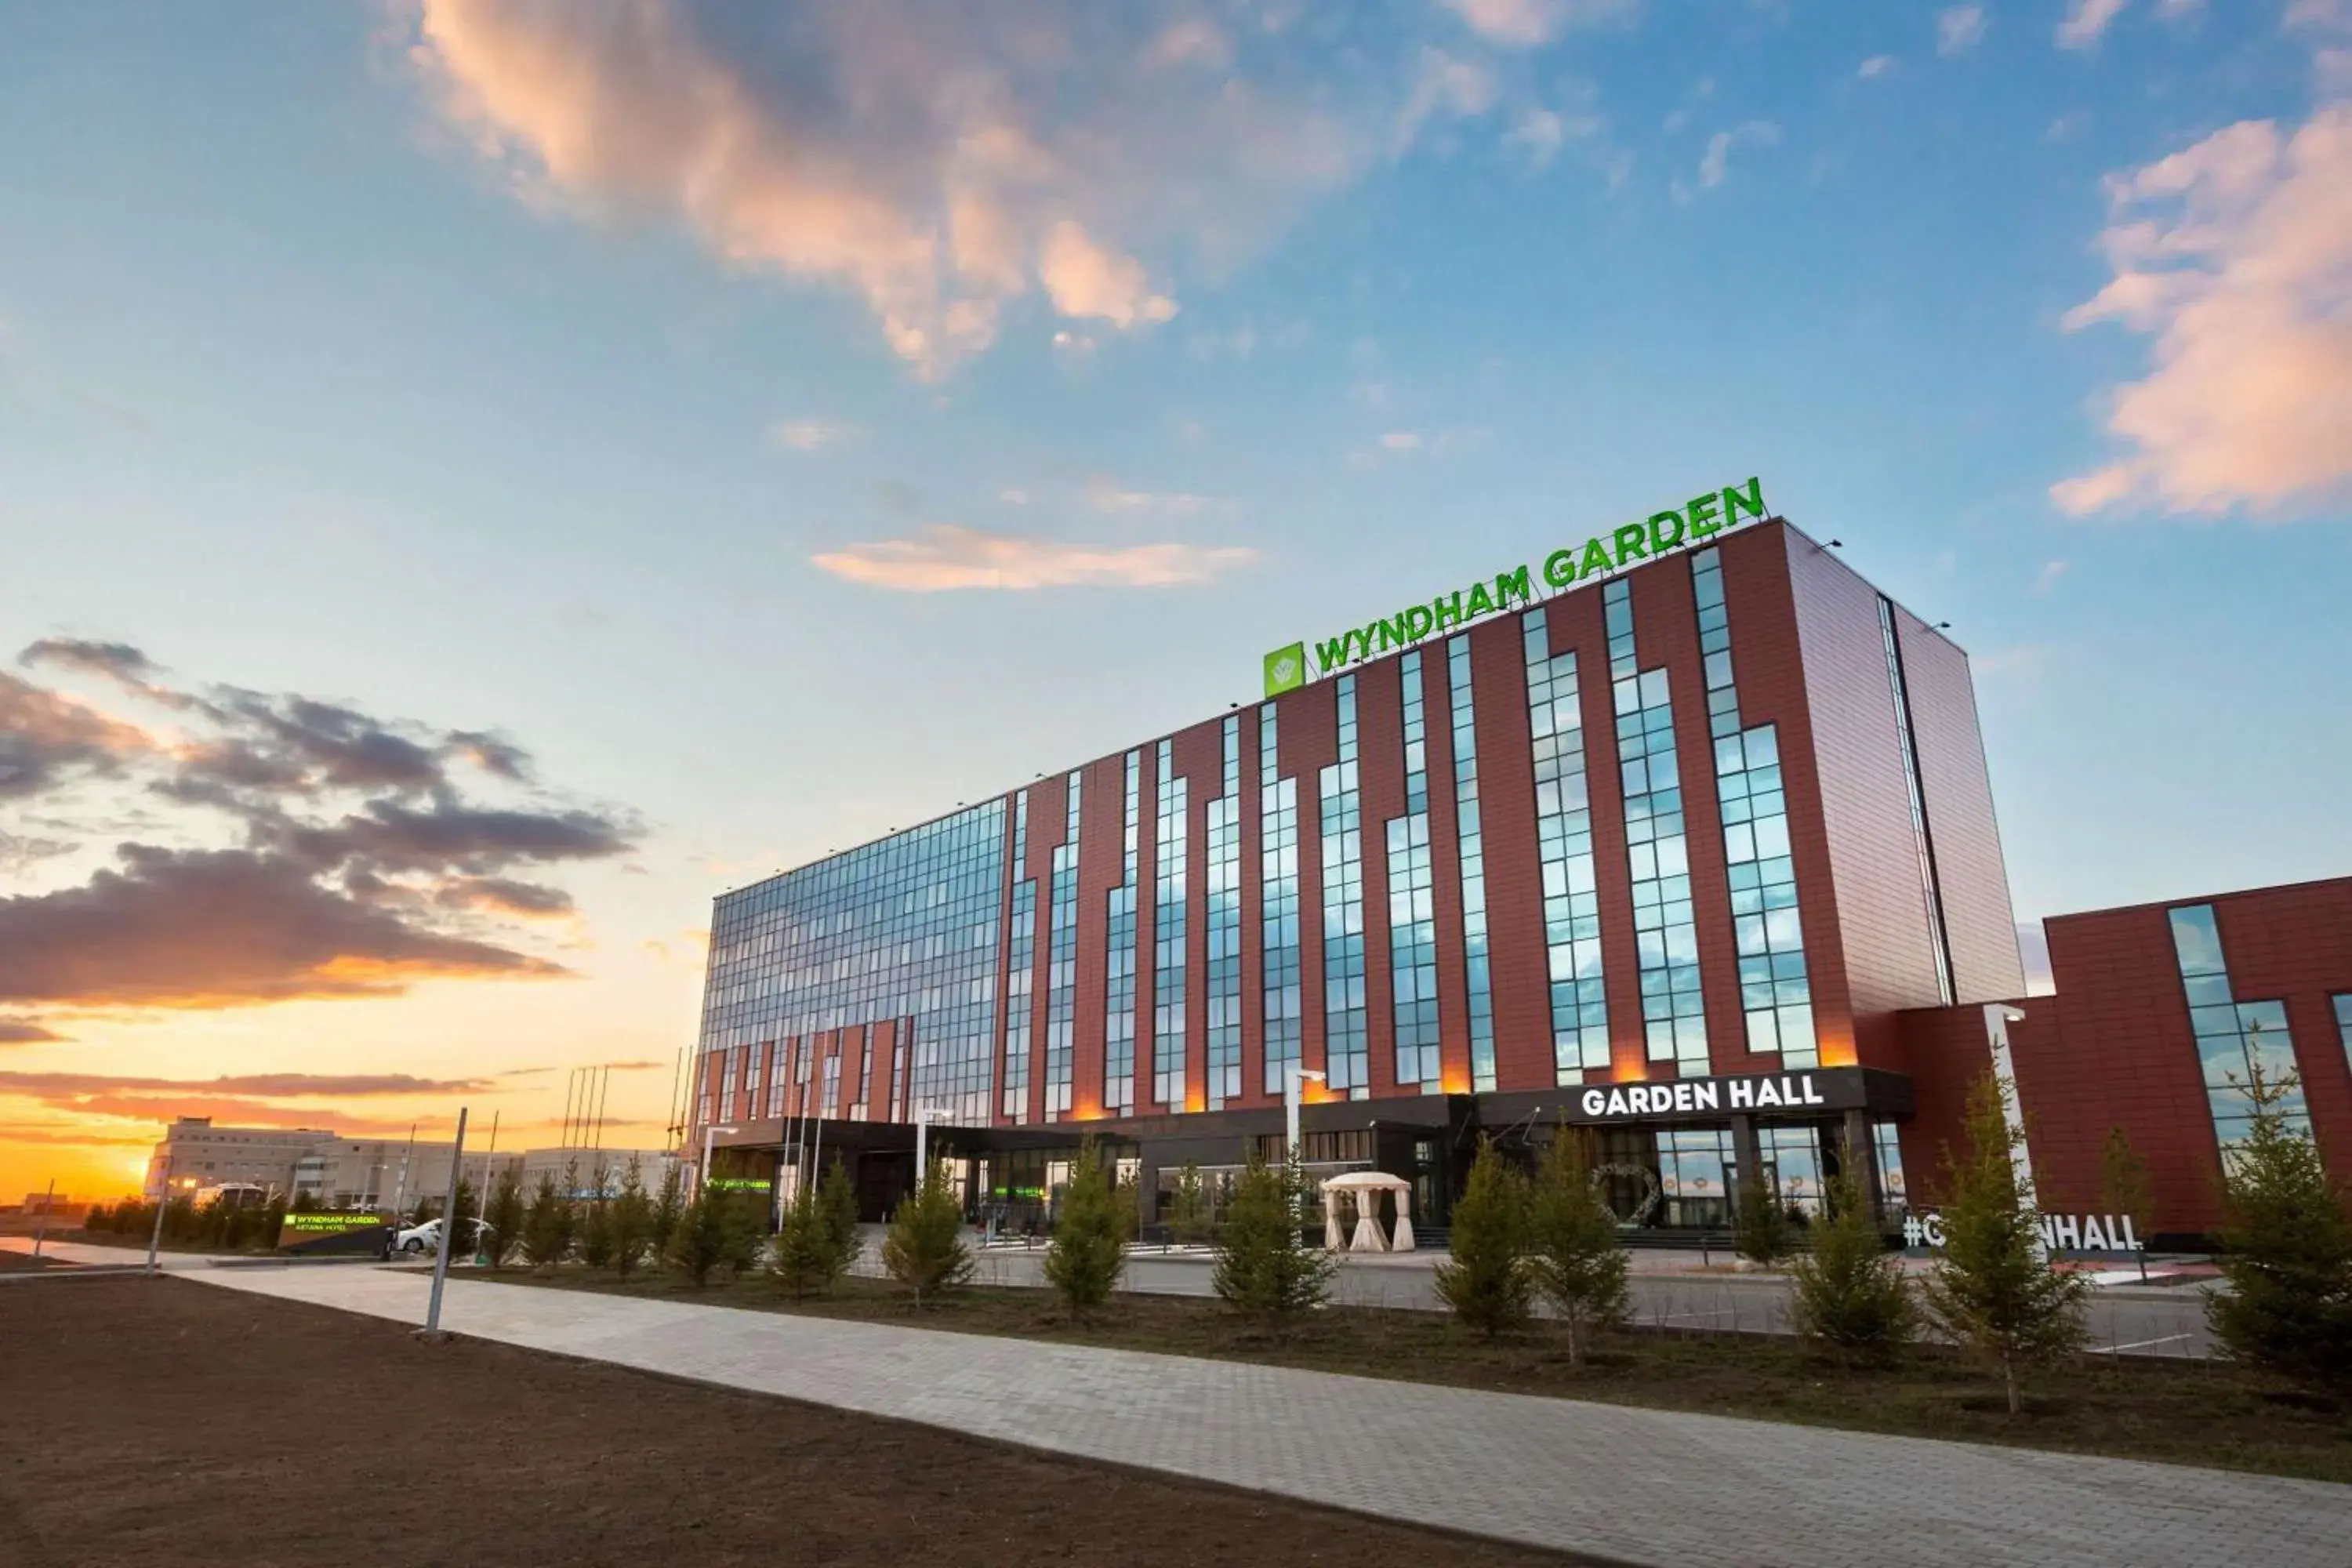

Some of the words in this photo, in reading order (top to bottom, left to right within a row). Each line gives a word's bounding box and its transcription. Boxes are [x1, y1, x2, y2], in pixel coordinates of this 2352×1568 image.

[1315, 564, 1529, 672] WYNDHAM
[1543, 476, 1763, 588] GARDEN
[1582, 1081, 1718, 1116] GARDEN
[1728, 1076, 1824, 1108] HALL
[1903, 1214, 2143, 1251] #GNHALL
